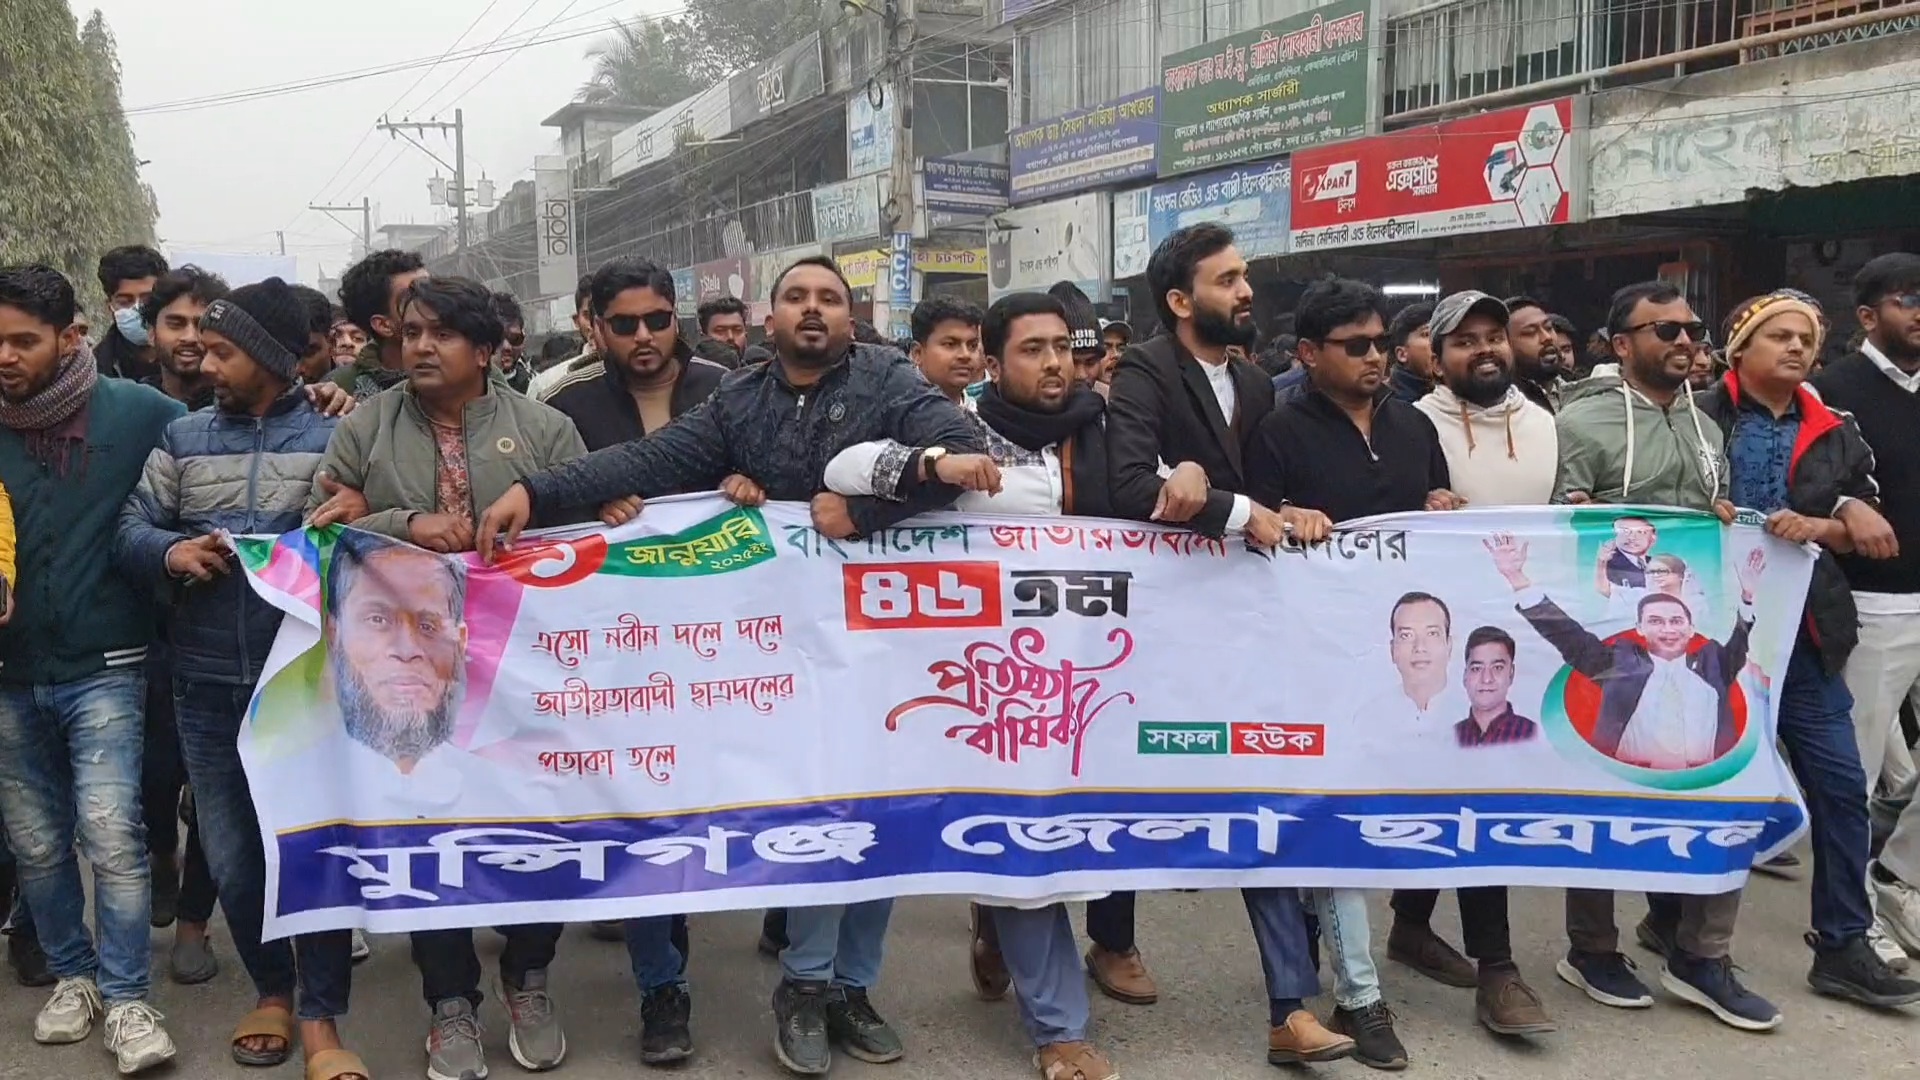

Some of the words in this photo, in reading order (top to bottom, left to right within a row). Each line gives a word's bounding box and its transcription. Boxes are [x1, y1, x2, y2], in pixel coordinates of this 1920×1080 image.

[1206, 94, 1254, 115] অধ্যাপক
[1258, 80, 1299, 101] সার্জারী
[625, 515, 760, 566] জানুয়ারি
[861, 570, 983, 618] ৪৬
[1011, 570, 1133, 618] তম
[532, 629, 590, 667] এসো
[602, 613, 660, 651] নবীন
[672, 622, 722, 659] দলে
[736, 615, 782, 653] দলে
[532, 672, 676, 717] জাতীয়তাবাদী
[688, 674, 794, 712] ছাত্রদলের
[1144, 728, 1221, 751] সফল
[1239, 723, 1316, 753] হউক
[538, 749, 614, 777] পতাকা
[626, 745, 676, 782] তলে
[941, 806, 1303, 855] জেলা
